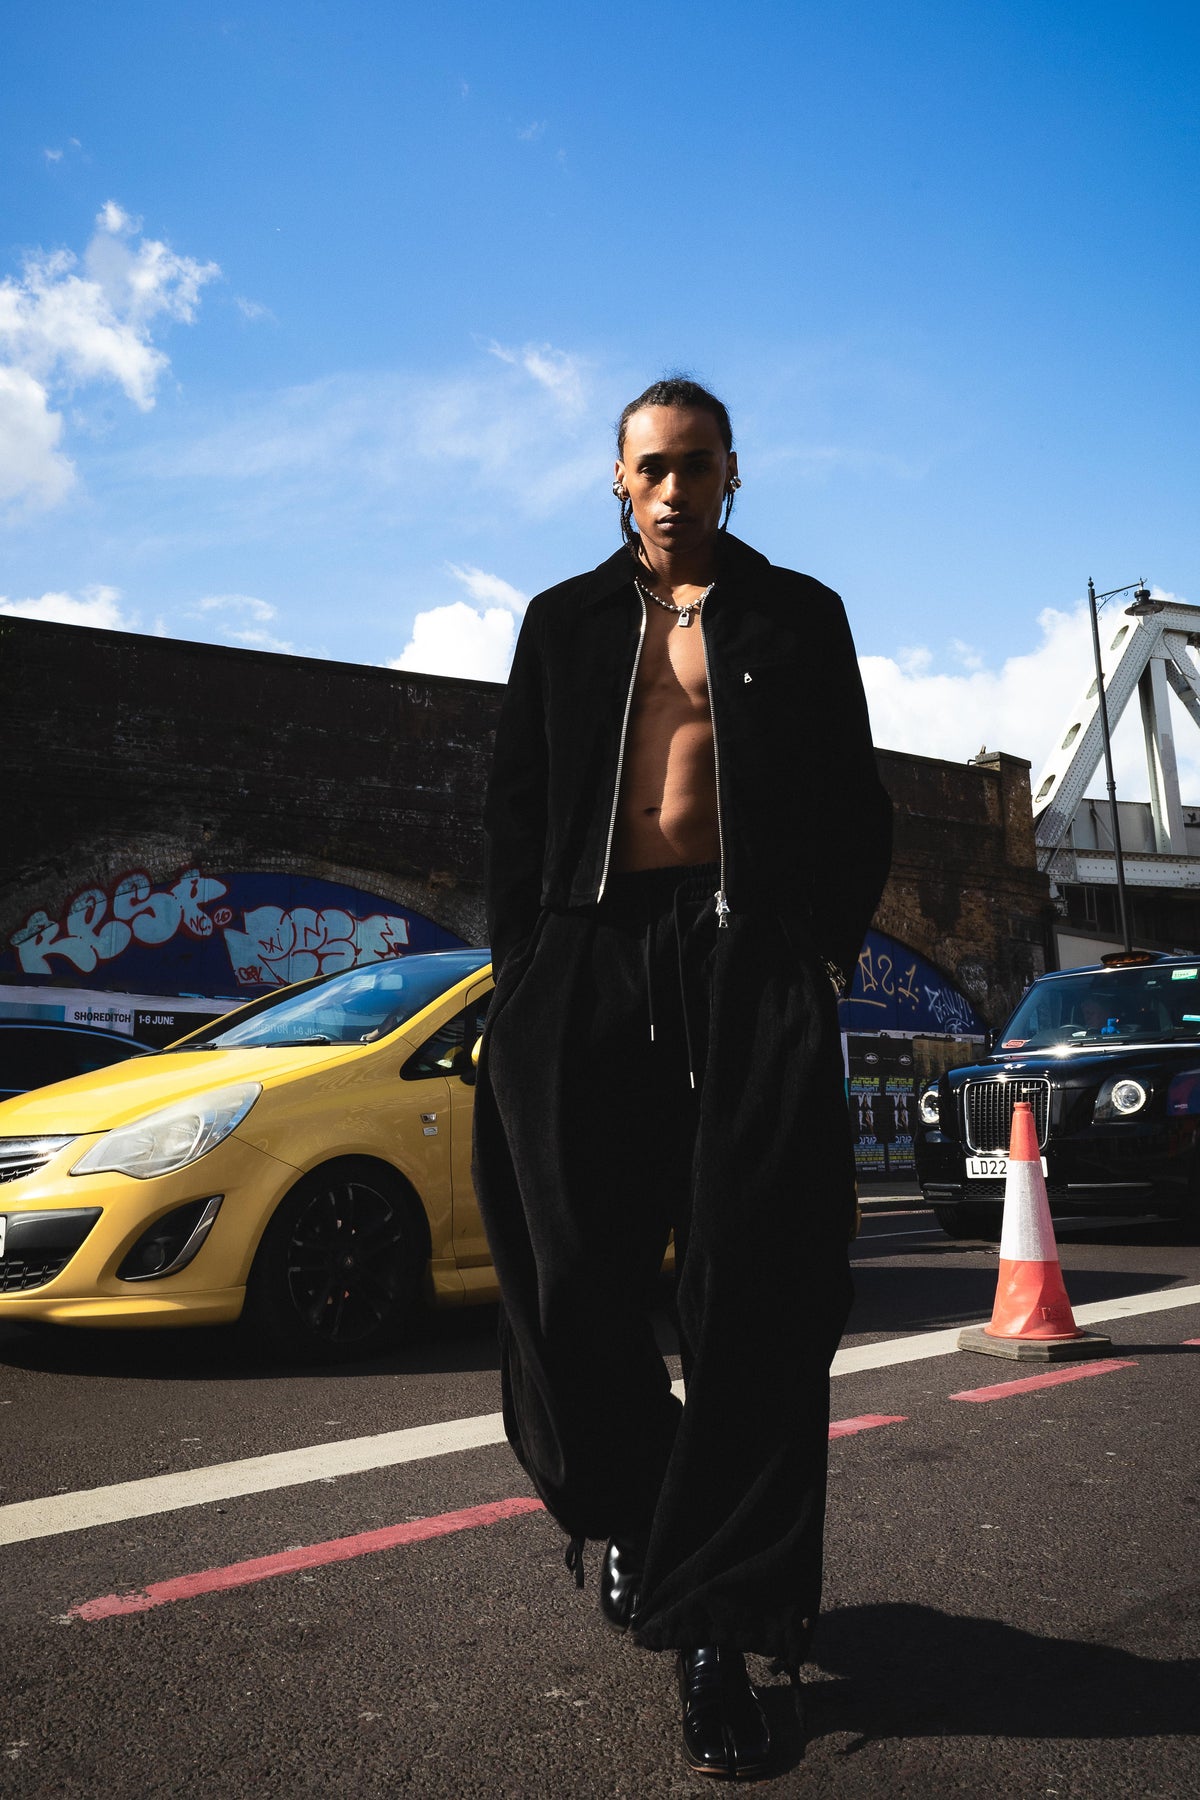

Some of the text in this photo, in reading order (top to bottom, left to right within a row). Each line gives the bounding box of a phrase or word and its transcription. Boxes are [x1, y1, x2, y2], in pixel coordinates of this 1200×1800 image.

[74, 1011, 175, 1025] SHOREDITCH 1-6 JUNE
[971, 1161, 1007, 1175] LD22
